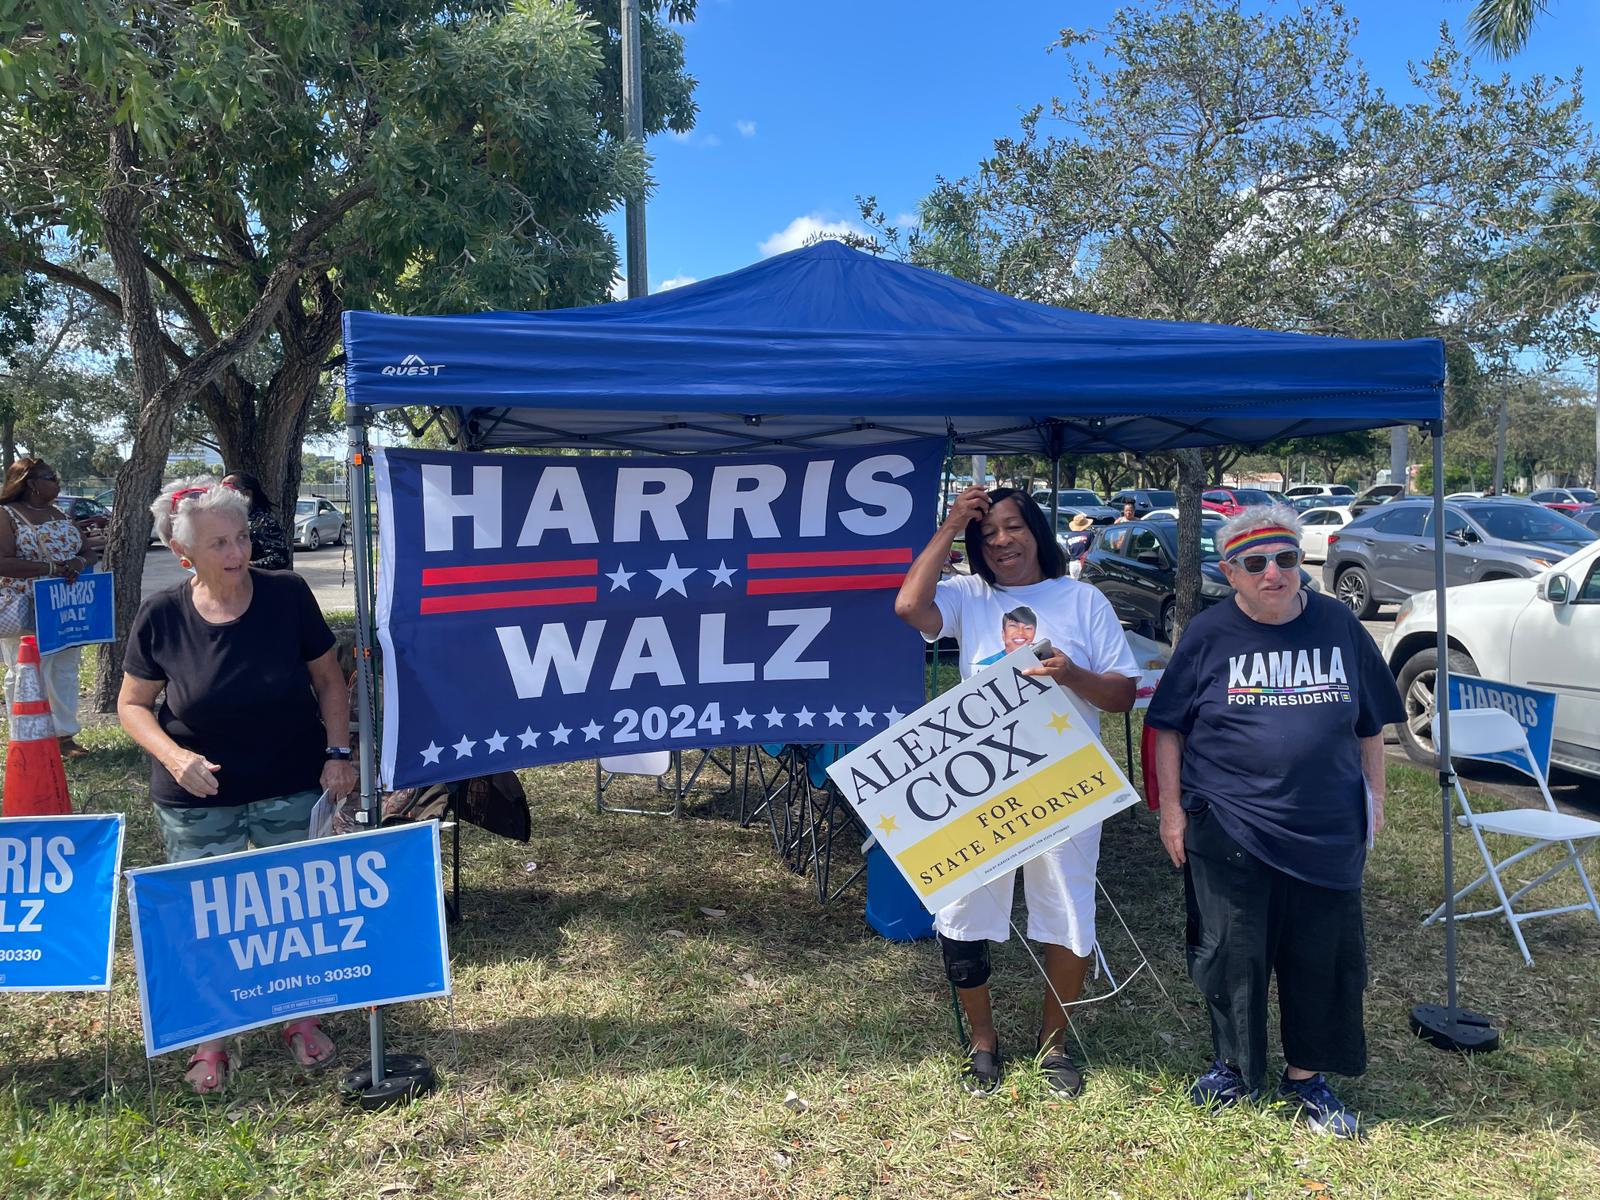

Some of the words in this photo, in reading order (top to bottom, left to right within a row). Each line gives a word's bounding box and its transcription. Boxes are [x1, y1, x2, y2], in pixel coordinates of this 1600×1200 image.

[381, 365, 445, 376] QUEST
[421, 455, 915, 552] HARRIS
[496, 607, 831, 699] WALZ
[1228, 646, 1348, 688] KAMALA
[613, 702, 725, 744] 2024
[1228, 694, 1256, 705] FOR
[1260, 691, 1340, 706] PRESIDENT
[1458, 683, 1538, 727] HARRIS
[850, 666, 1052, 805] ALEXCIA
[906, 720, 1048, 821] COX
[920, 840, 986, 886] STATE
[991, 771, 1107, 844] ATTORNEY
[976, 796, 1024, 828] FOR
[190, 851, 389, 940] HARRIS
[228, 915, 367, 971] WALZ
[230, 984, 264, 1001] Text
[267, 975, 302, 994] JOIN
[306, 974, 321, 986] to
[324, 964, 372, 983] 30330
